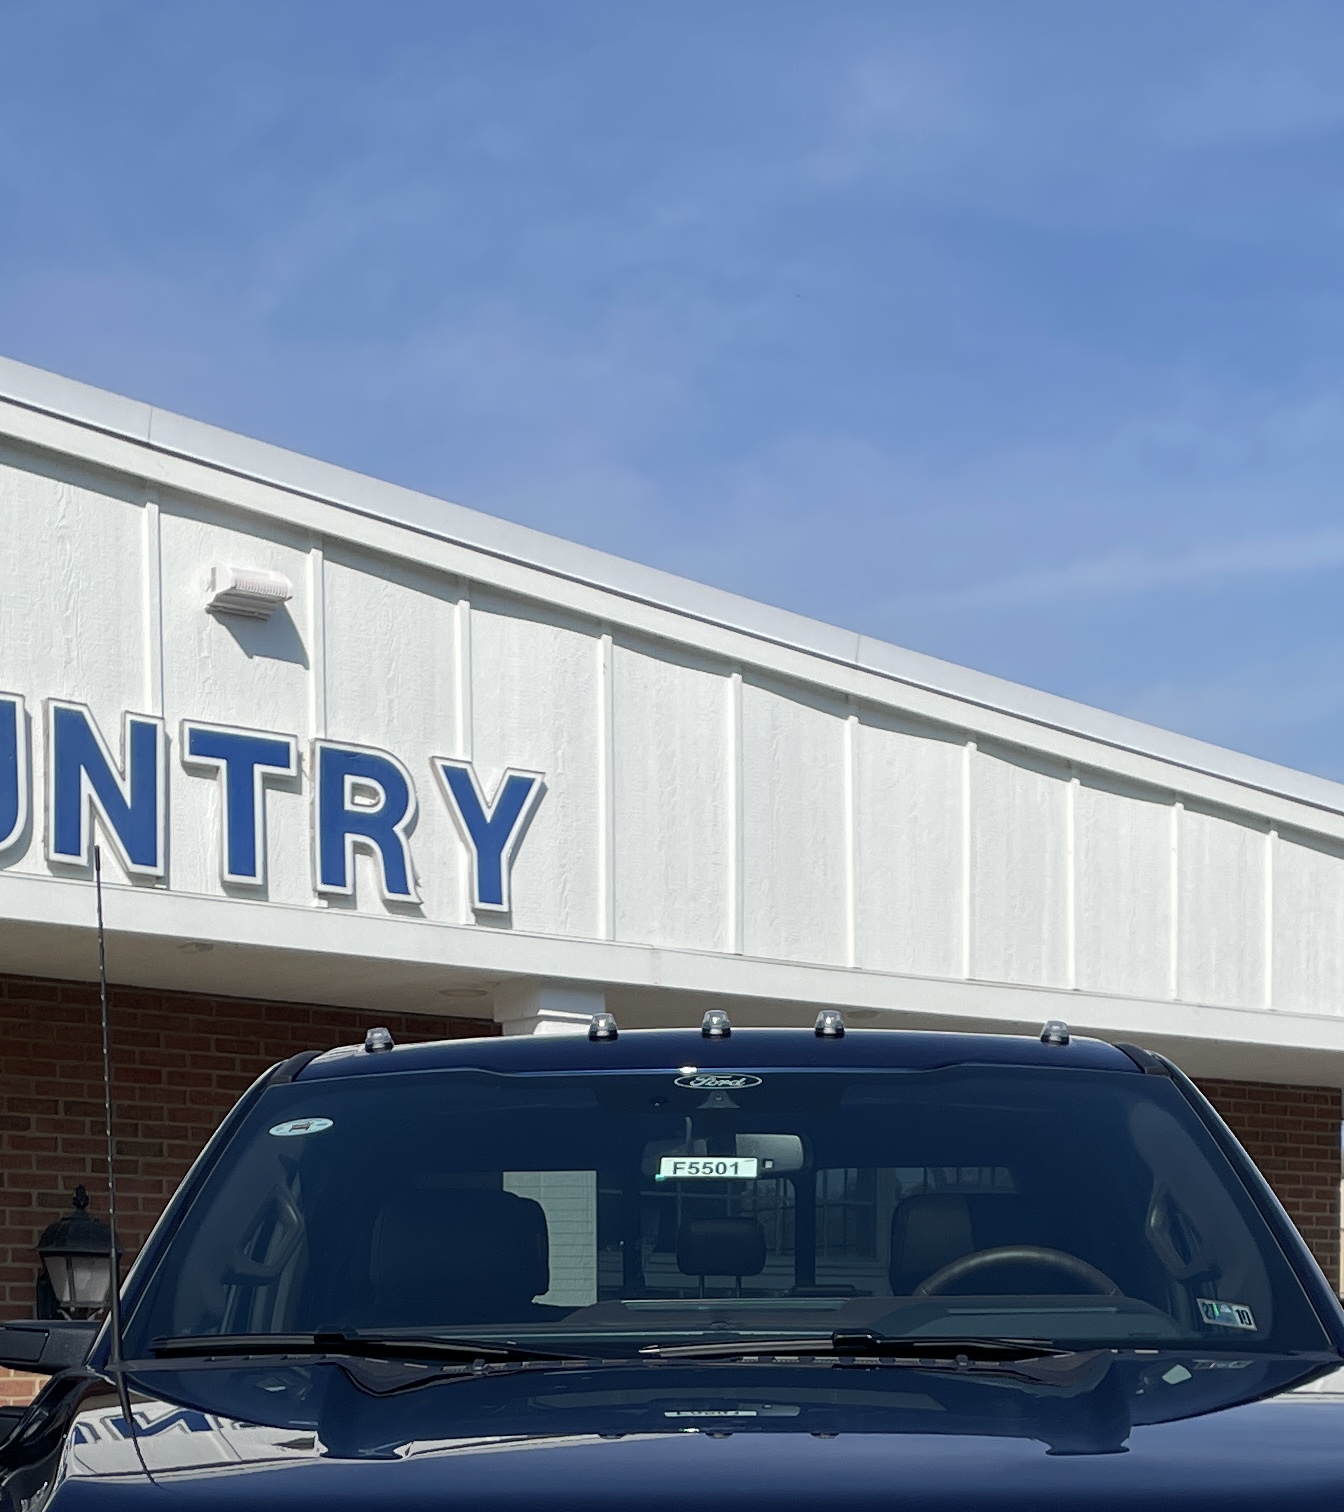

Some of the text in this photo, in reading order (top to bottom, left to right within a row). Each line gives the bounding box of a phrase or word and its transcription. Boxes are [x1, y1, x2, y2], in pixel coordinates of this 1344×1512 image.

[689, 1075, 747, 1087] Ford
[673, 1161, 739, 1175] F5501
[1236, 1308, 1253, 1326] 10
